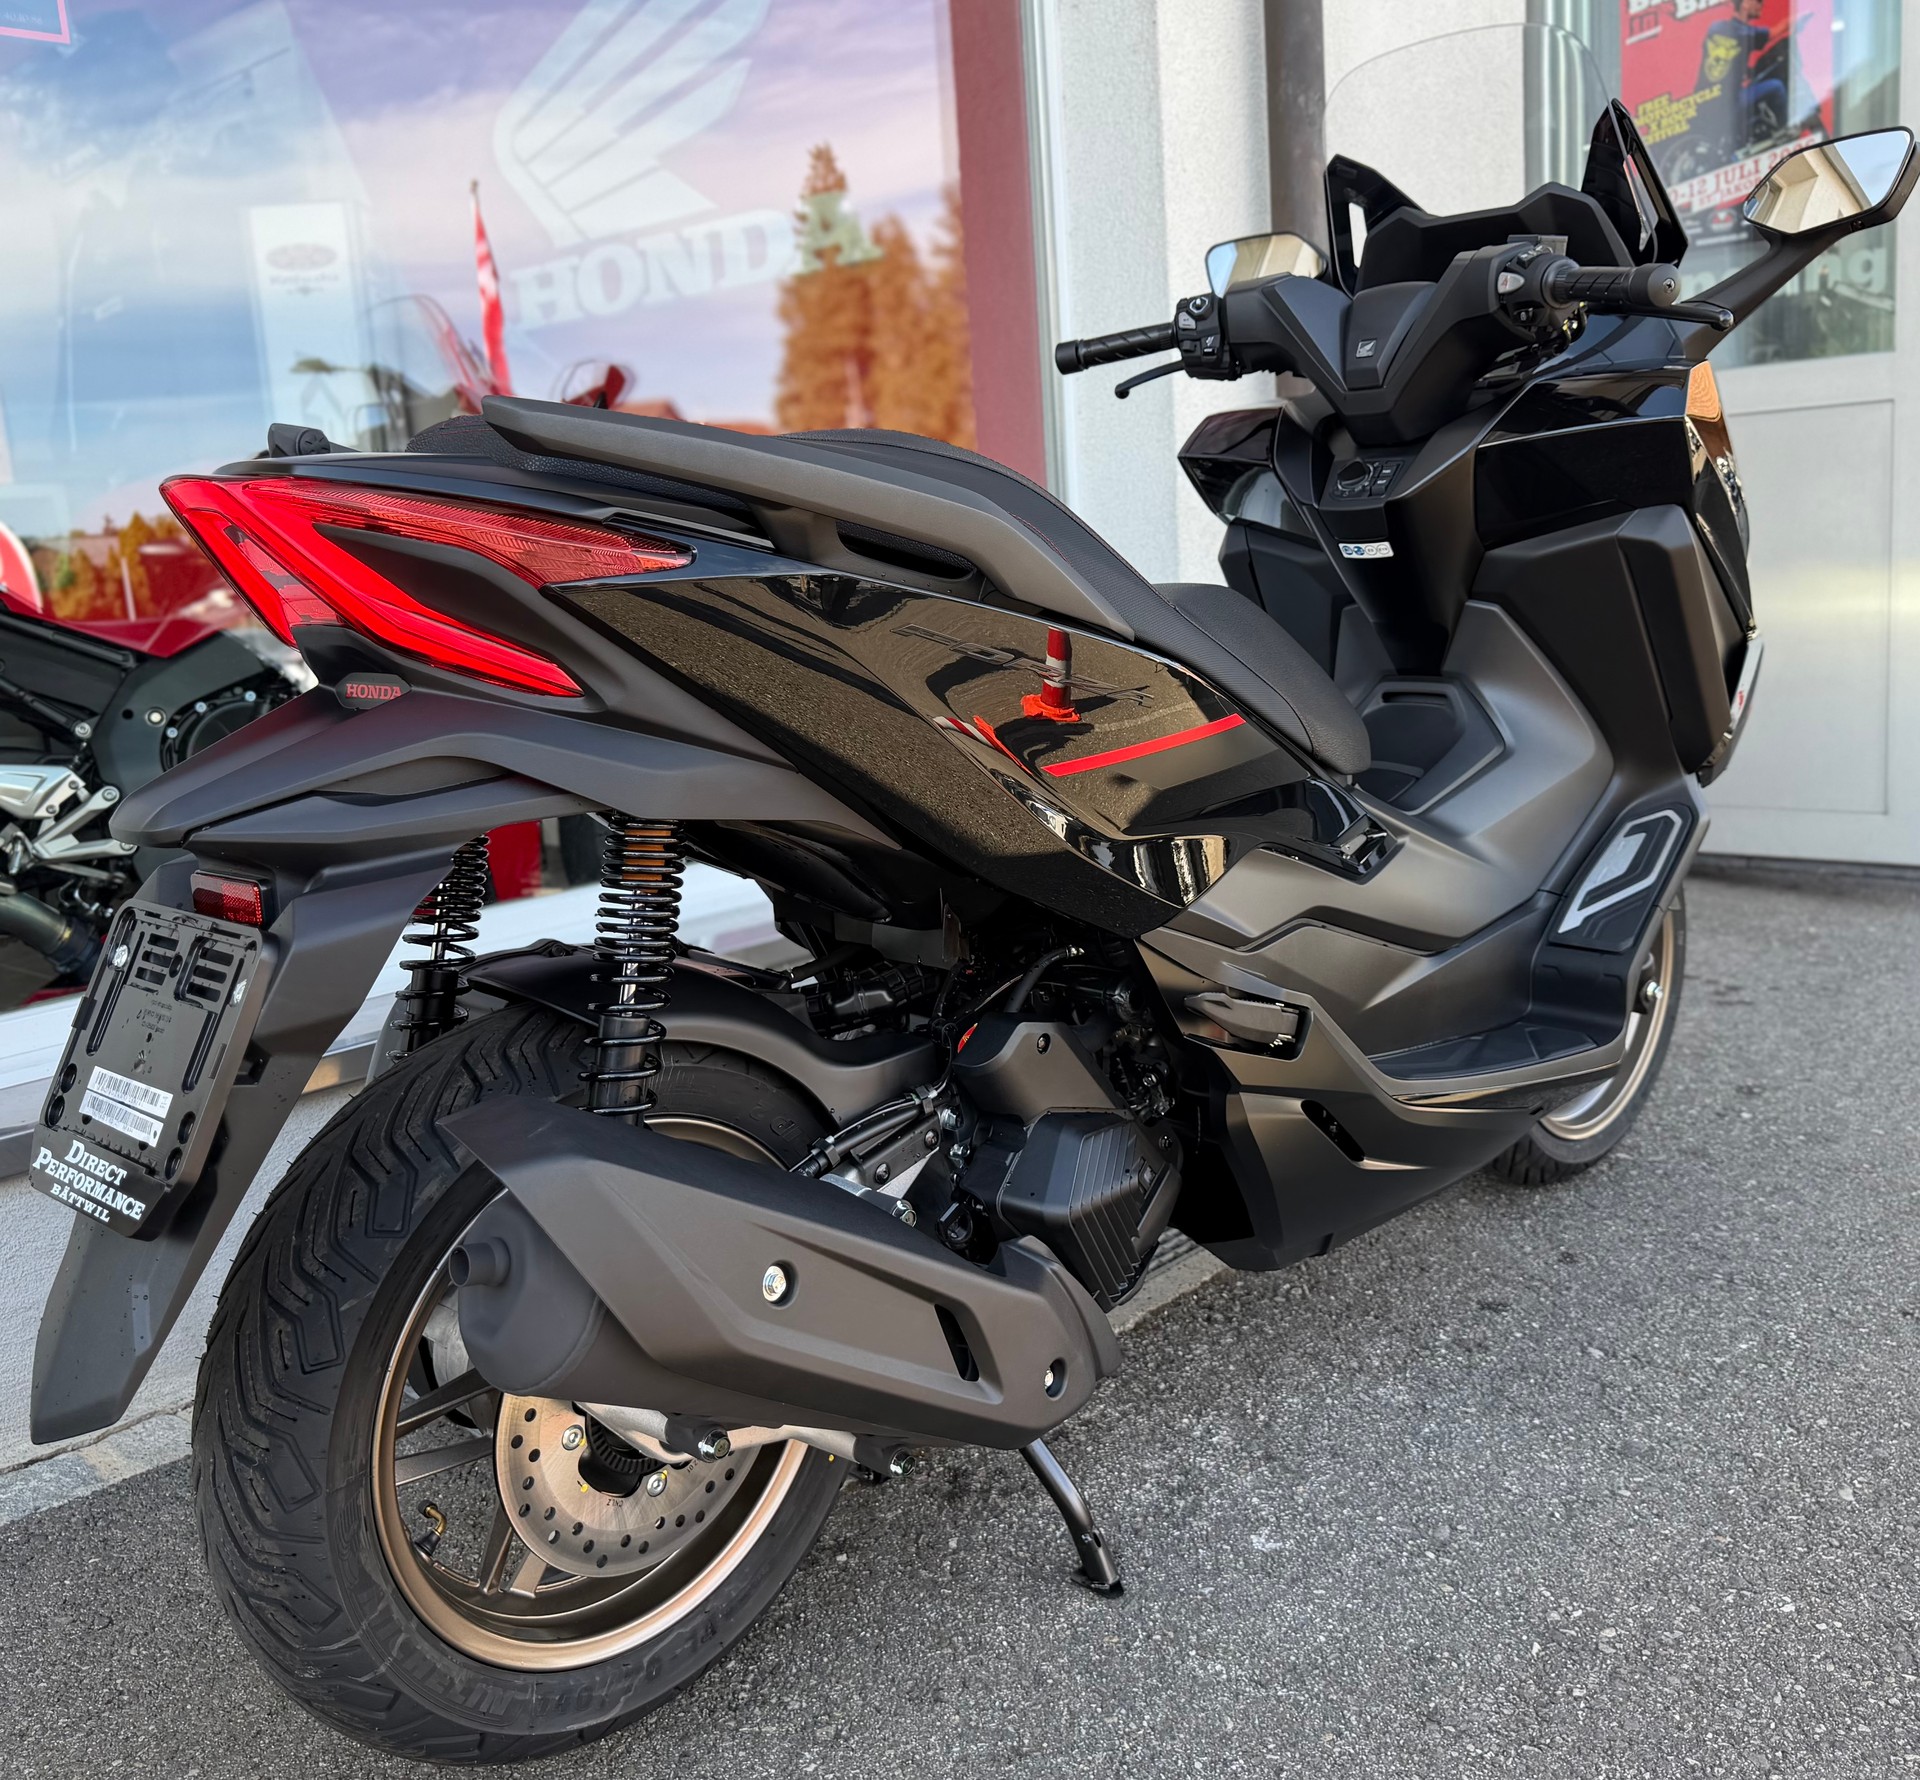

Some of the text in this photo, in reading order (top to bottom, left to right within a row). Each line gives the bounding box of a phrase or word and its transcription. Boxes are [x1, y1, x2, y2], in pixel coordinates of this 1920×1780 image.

[1714, 157, 1761, 191] JULI
[508, 192, 886, 330] HONDA
[345, 683, 402, 700] HONDA
[32, 1146, 146, 1220] PERFORMANCE
[64, 1139, 128, 1186] DIRECT
[50, 1183, 111, 1223] BÄTTWIL
